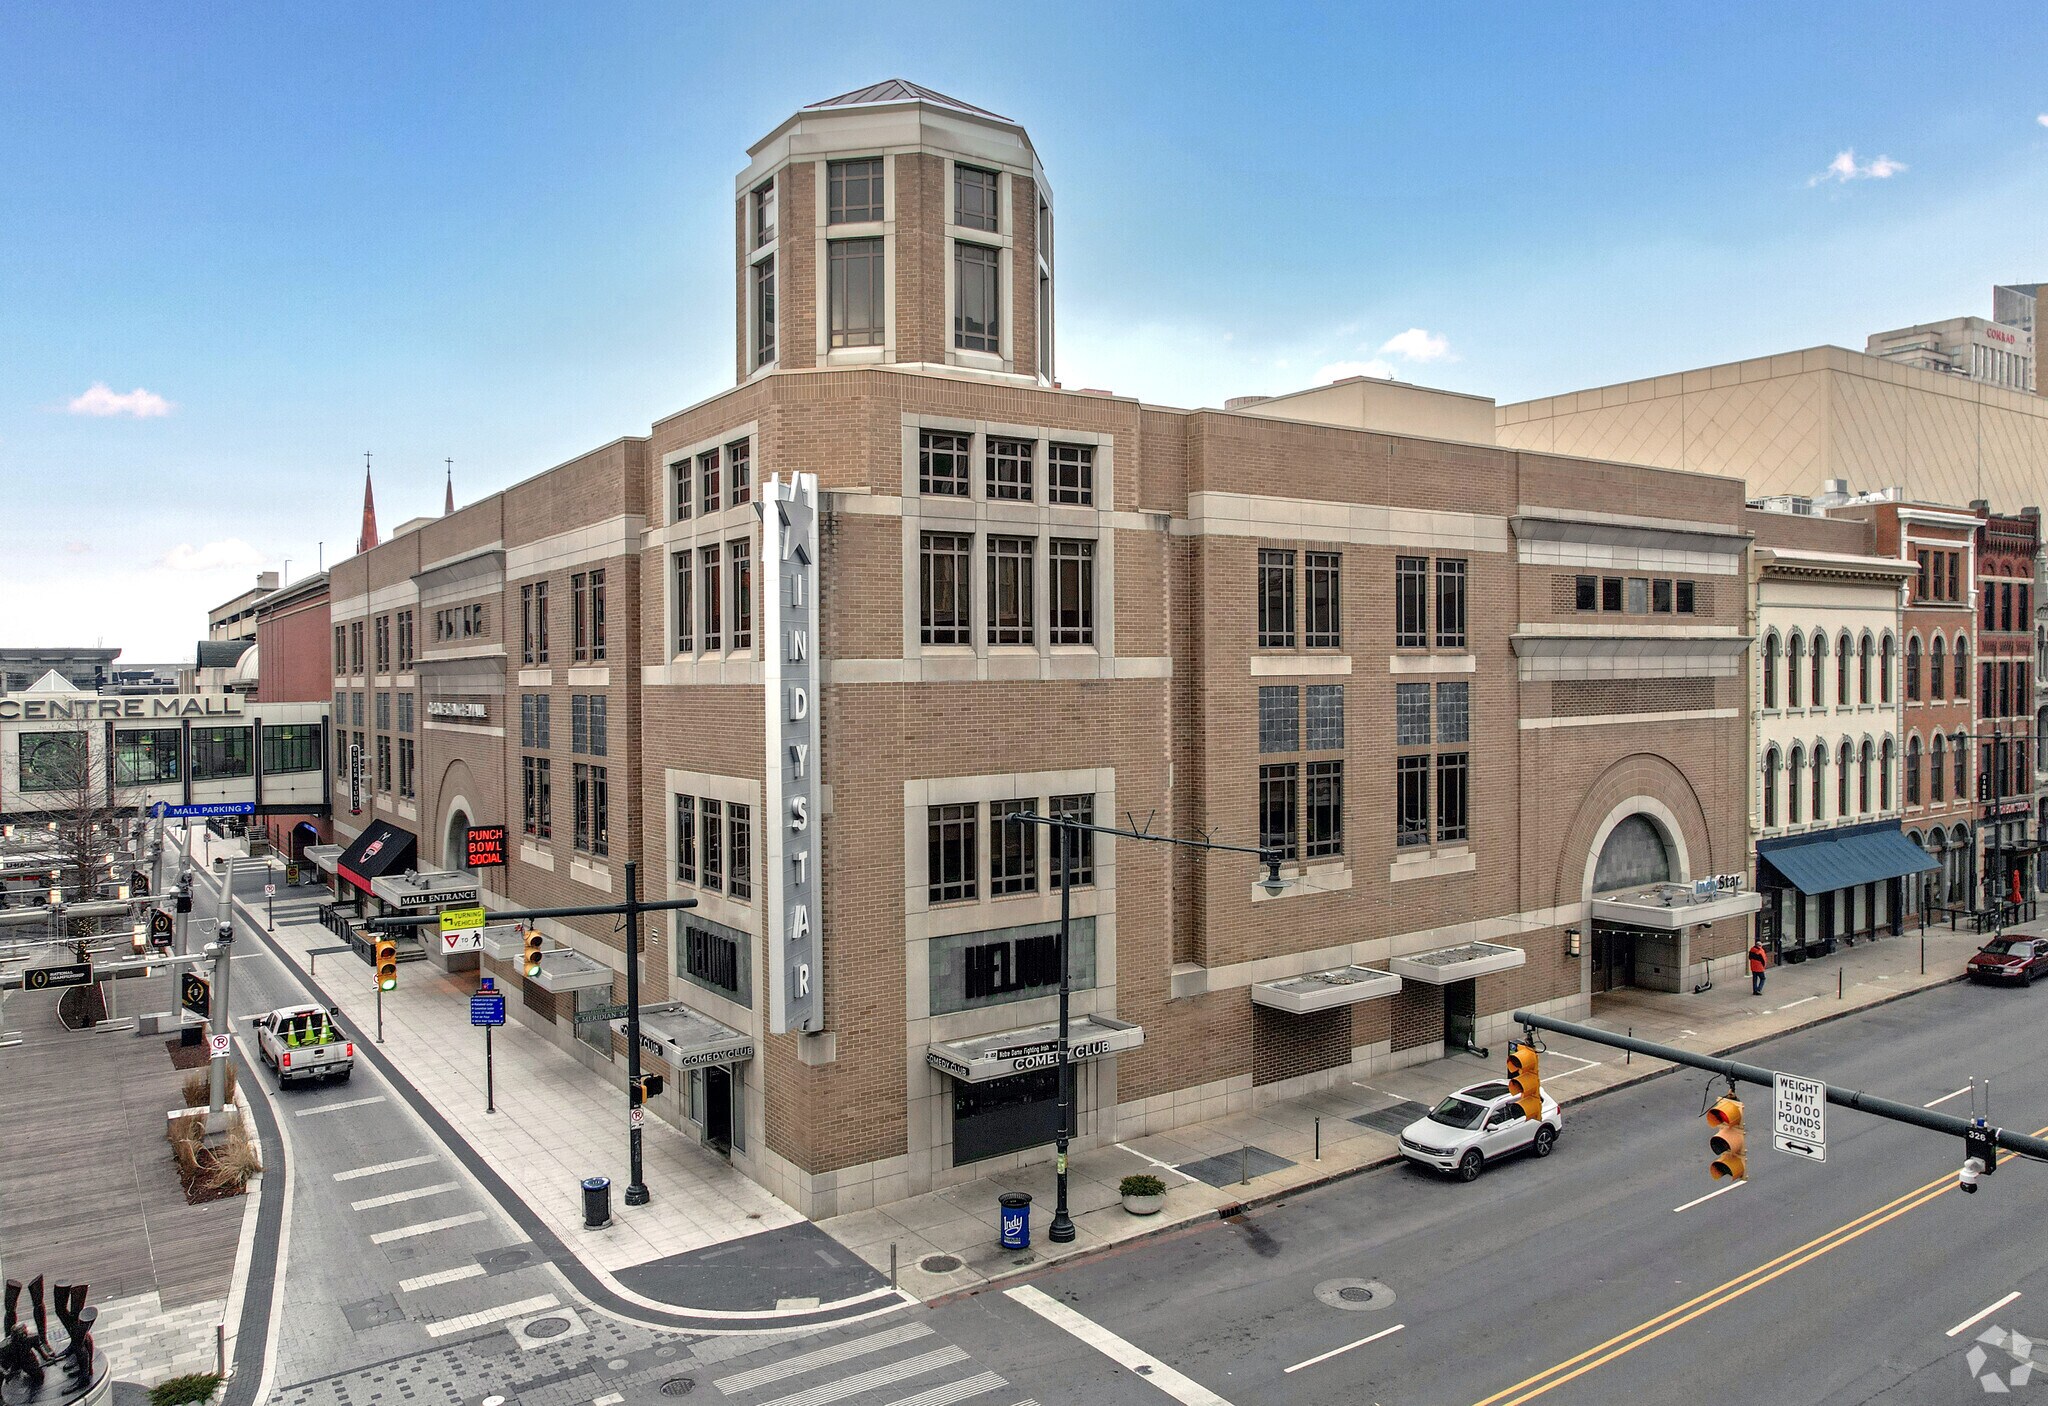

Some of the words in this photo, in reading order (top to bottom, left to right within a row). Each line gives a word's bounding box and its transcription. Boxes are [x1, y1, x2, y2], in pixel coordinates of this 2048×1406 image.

[1986, 327, 2016, 345] CONRAD
[0, 699, 145, 719] CENTRE
[153, 697, 241, 716] MALL
[173, 807, 199, 815] MALL
[202, 805, 242, 813] PARKING
[468, 829, 503, 841] PUNCH
[468, 841, 503, 853] BOWL
[468, 852, 503, 865] SOCIAL
[402, 895, 426, 905] MALL
[429, 890, 476, 902] ENTRANCE
[453, 918, 483, 926] VEHICLES
[454, 911, 482, 919] TURNING
[582, 1012, 617, 1022] MERIDIAN
[682, 1051, 726, 1066] COMEDY
[727, 1046, 754, 1058] CLUB
[1014, 1047, 1073, 1071] COMEY
[1075, 1041, 1110, 1058] CLUB
[1023, 1046, 1040, 1056] Fighting
[926, 1053, 950, 1069] COMEDY
[949, 1063, 967, 1076] CLUB
[1780, 1077, 1819, 1095] WEIGHT
[1784, 1090, 1815, 1105] LIMIT
[1779, 1100, 1820, 1118] 15000
[1778, 1111, 1821, 1130] POUNDS
[1783, 1124, 1816, 1139] GROSS
[1968, 1130, 1986, 1142] 326
[1003, 1214, 1023, 1237] Indy
